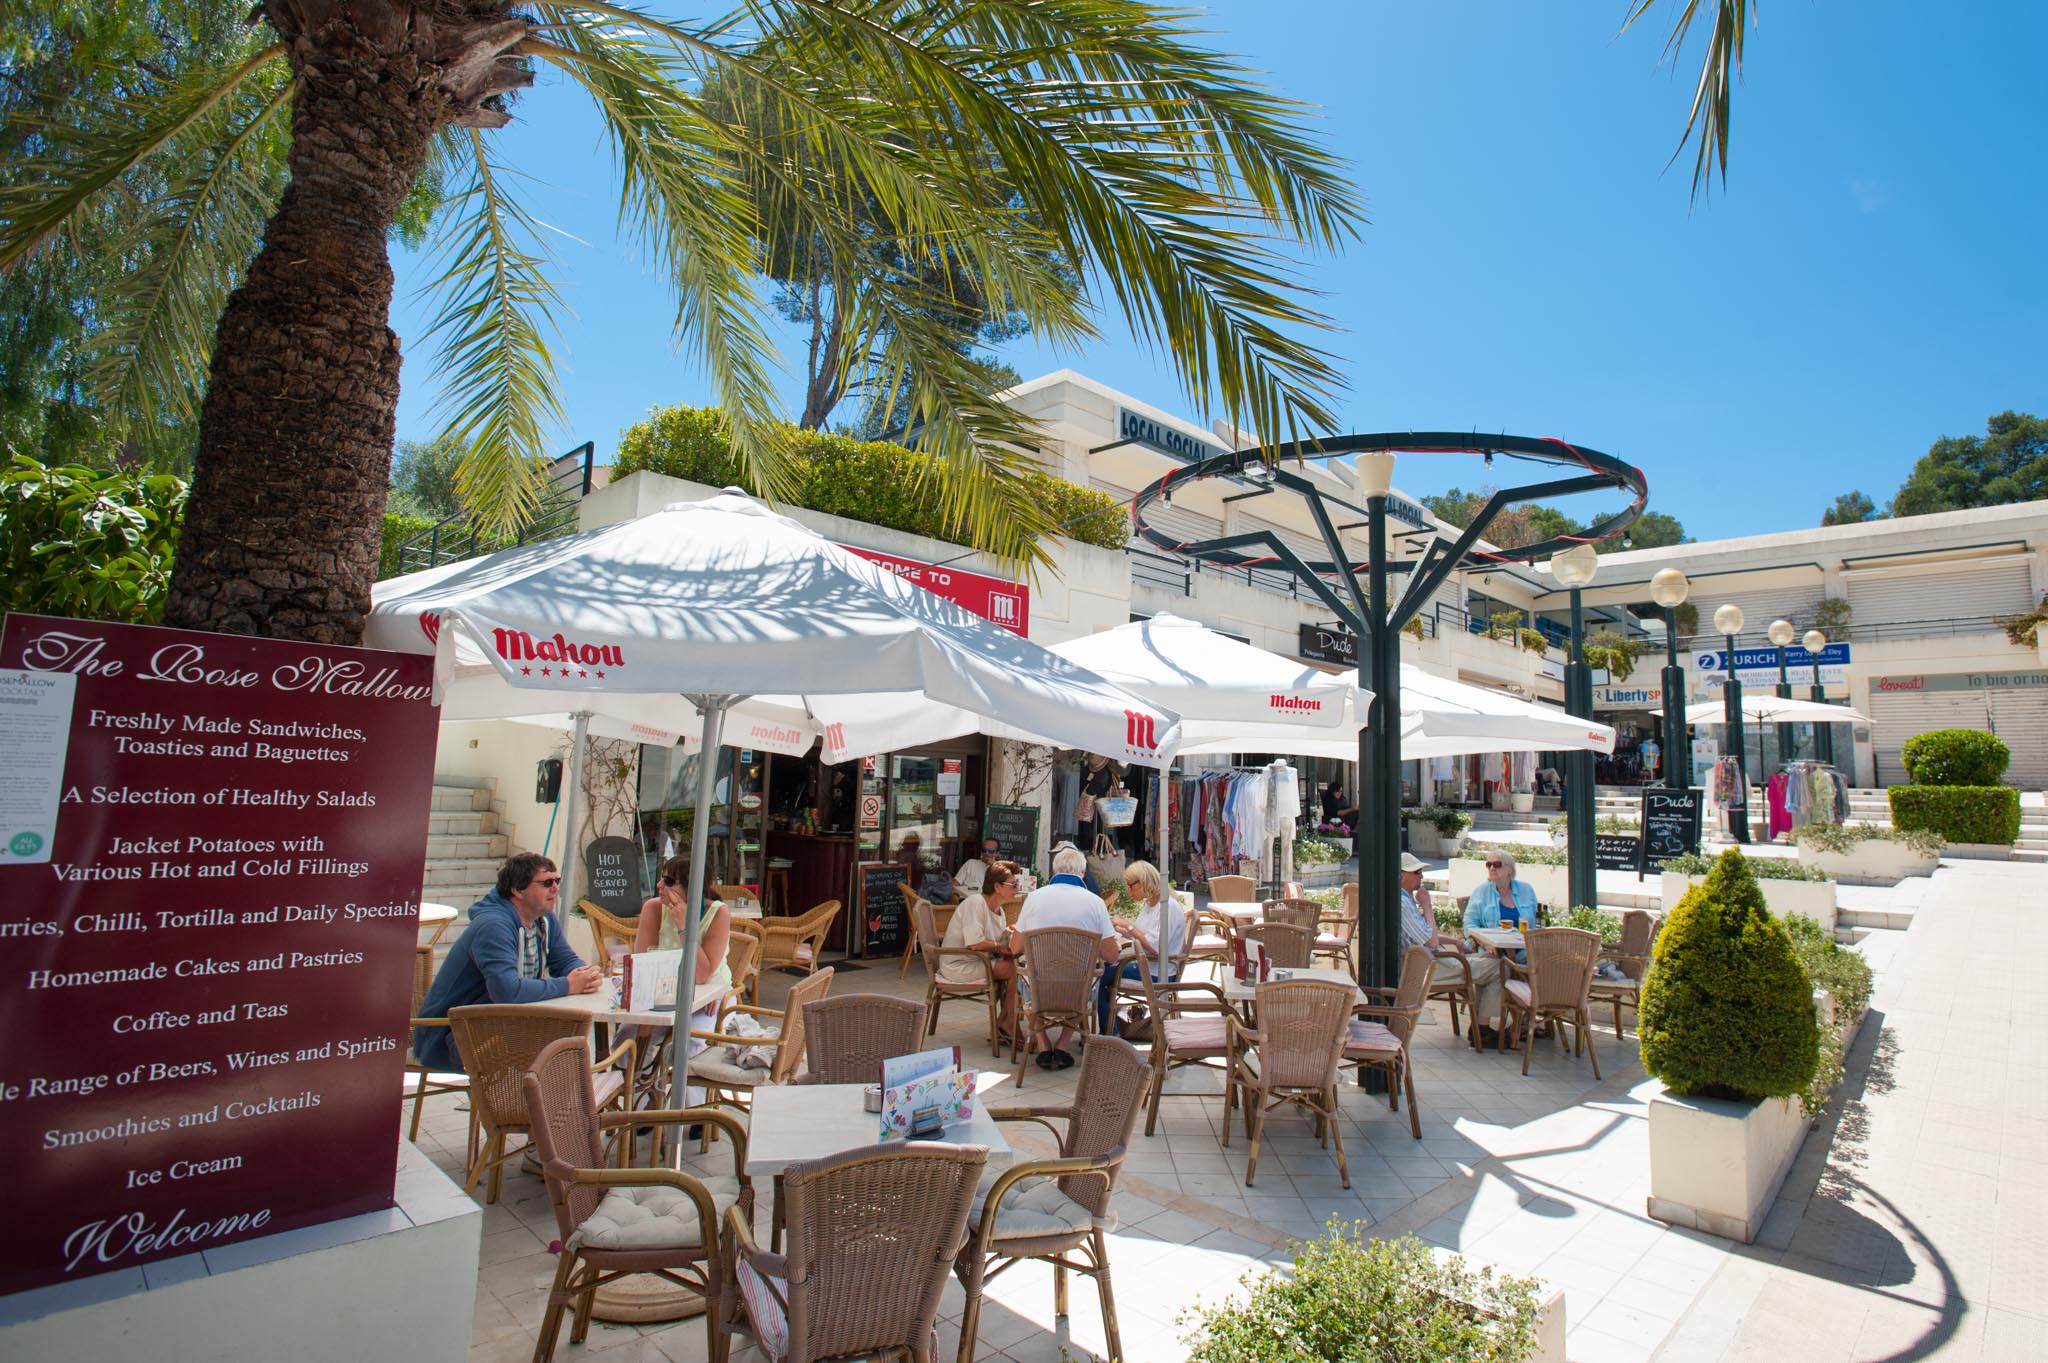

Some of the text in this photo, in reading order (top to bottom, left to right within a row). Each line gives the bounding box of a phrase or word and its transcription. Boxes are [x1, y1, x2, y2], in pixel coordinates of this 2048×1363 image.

[1122, 412, 1205, 461] LOCAL SOCIAL
[929, 571, 951, 585] TO
[492, 627, 625, 667] Mahou
[1316, 632, 1352, 654] Dude
[20, 632, 434, 704] The Rose Mallow
[1701, 656, 1712, 668] Z
[1878, 674, 1925, 690] loveat!
[1966, 673, 1982, 687] To
[1987, 673, 2008, 686] bio
[2013, 674, 2028, 685] or
[1270, 694, 1321, 710] Mahou
[1605, 688, 1661, 703] LibertySP
[90, 710, 366, 742] Freshly Made Sandwiches,
[115, 737, 348, 763] Toasties and Baguettes
[64, 787, 375, 809] A Selection of Healthy Salads
[1649, 795, 1694, 808] Dude
[109, 836, 323, 854] Jacket Potatoes with
[53, 859, 368, 880] Various Hot and Cold Fillings
[599, 854, 623, 865] HOT
[594, 879, 627, 888] SERVED
[596, 868, 624, 877] FOOD
[601, 889, 625, 897] DAILY
[1, 901, 416, 936] rries, Chilli, Tortilla and Daily Specials
[29, 949, 363, 989] Homemade Cakes and Pastries
[113, 1003, 287, 1033] Coffee and Teas
[30, 1075, 108, 1096] Range
[117, 1065, 145, 1085] of
[149, 1062, 217, 1080] Beers,
[227, 1051, 289, 1069] Wines
[296, 1042, 330, 1061] and
[337, 1036, 395, 1058] Spirits
[44, 1092, 320, 1149] Smoothies and Cocktails
[128, 1156, 241, 1188] Ice Cream
[65, 1209, 273, 1272] Welcome
